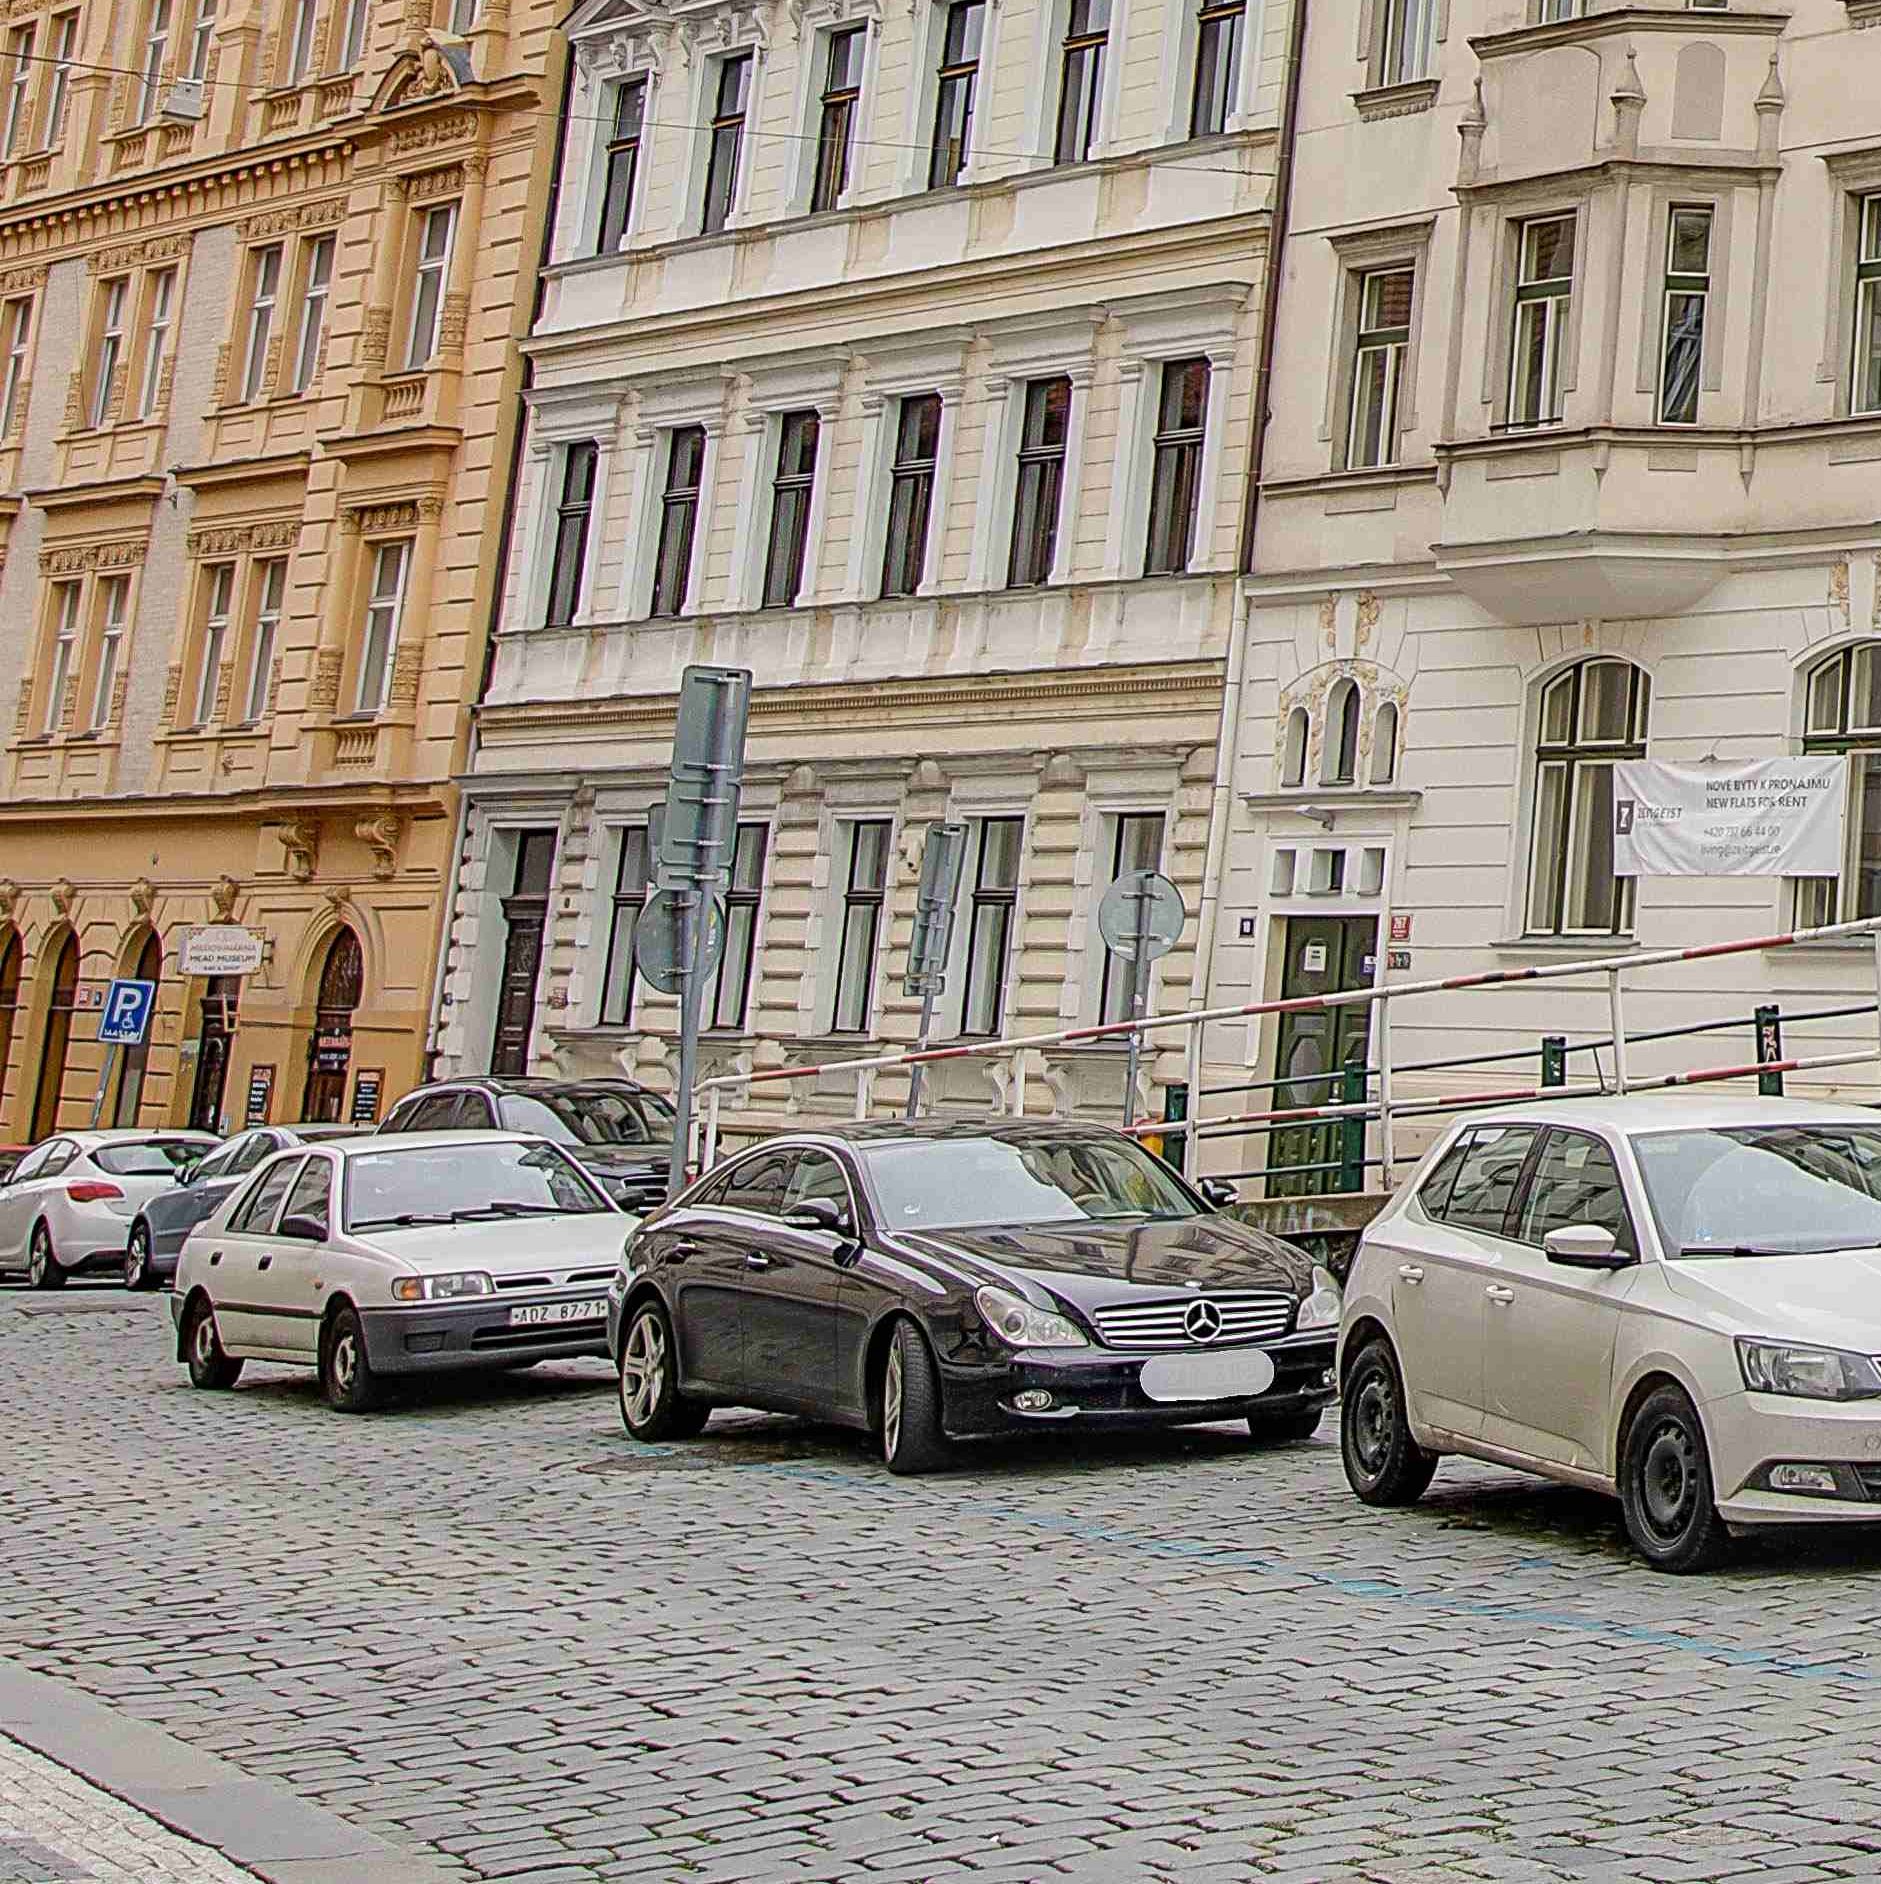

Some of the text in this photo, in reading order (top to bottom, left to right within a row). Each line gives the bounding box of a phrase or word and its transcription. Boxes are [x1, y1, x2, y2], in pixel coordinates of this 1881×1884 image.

[1706, 797, 1728, 809] NEW
[1778, 796, 1808, 808] RENT
[113, 987, 143, 1022] P
